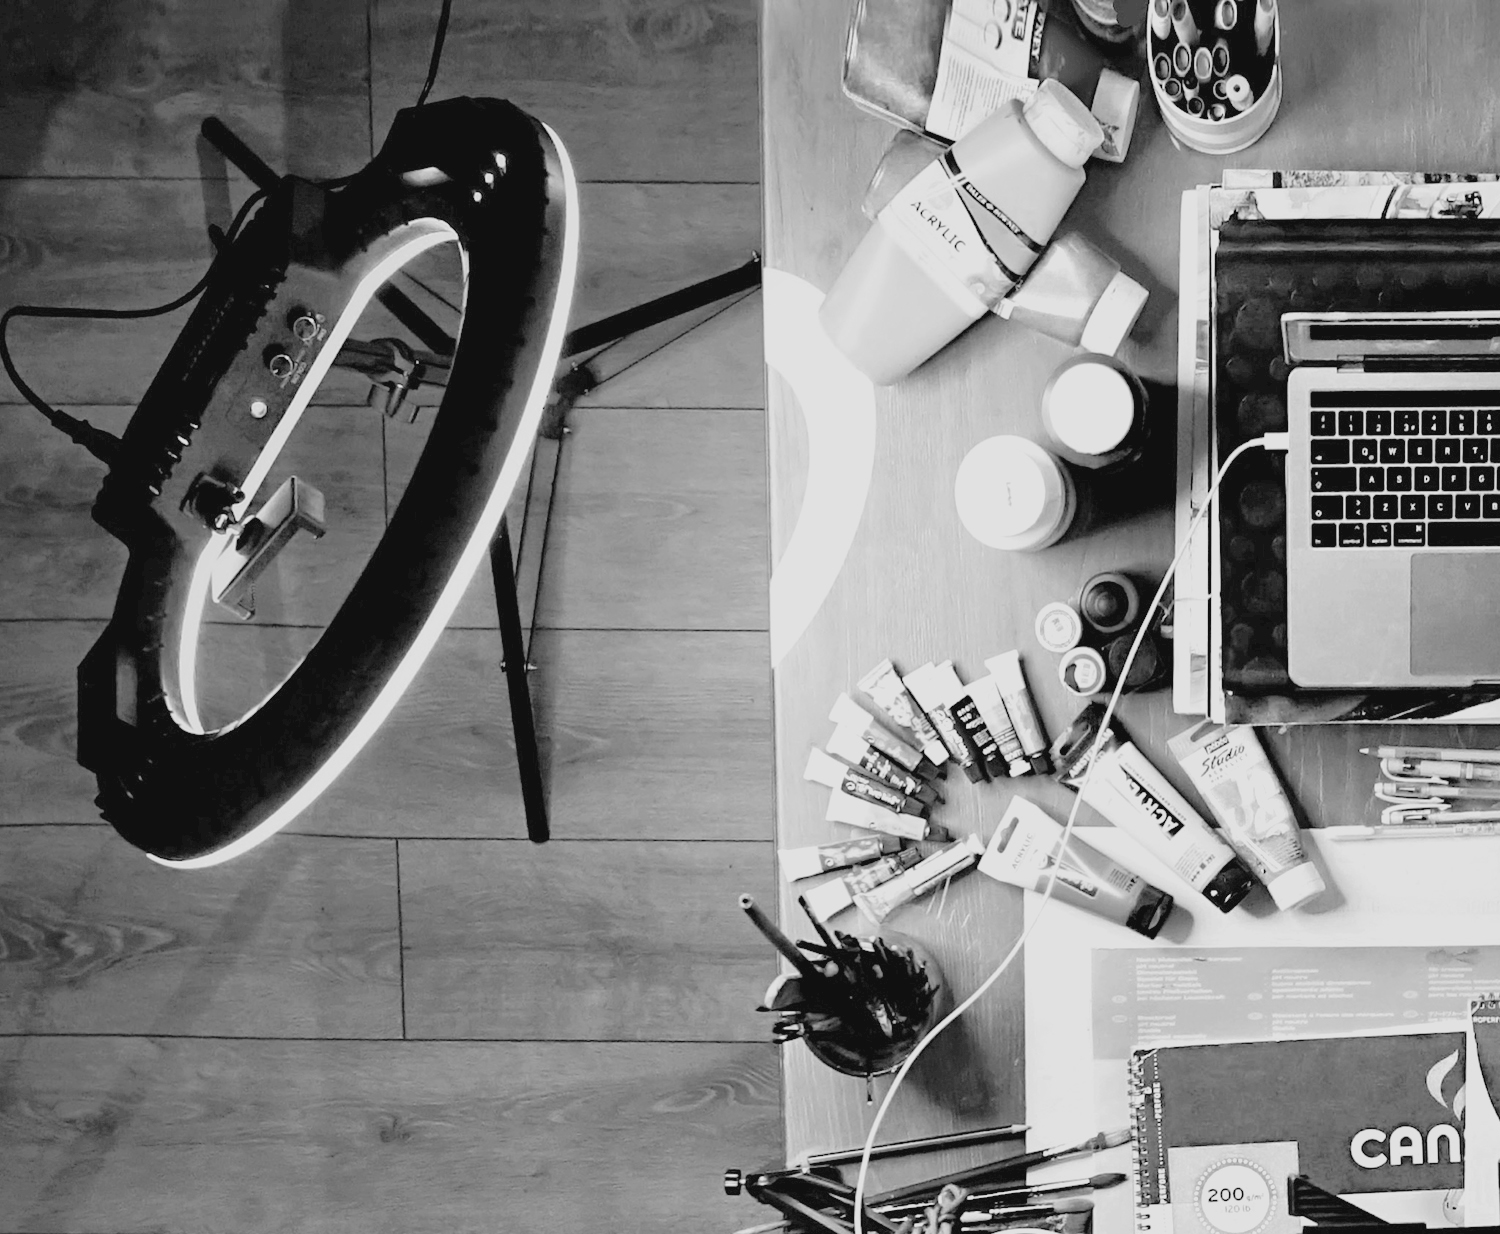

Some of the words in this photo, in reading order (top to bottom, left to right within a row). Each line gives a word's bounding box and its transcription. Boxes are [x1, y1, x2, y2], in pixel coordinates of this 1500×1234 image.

[910, 200, 967, 253] ACRYLIC
[1201, 745, 1246, 777] Studio
[1351, 1123, 1461, 1169] CAN
[1208, 1187, 1244, 1202] 200
[1225, 1205, 1240, 1213] 120
